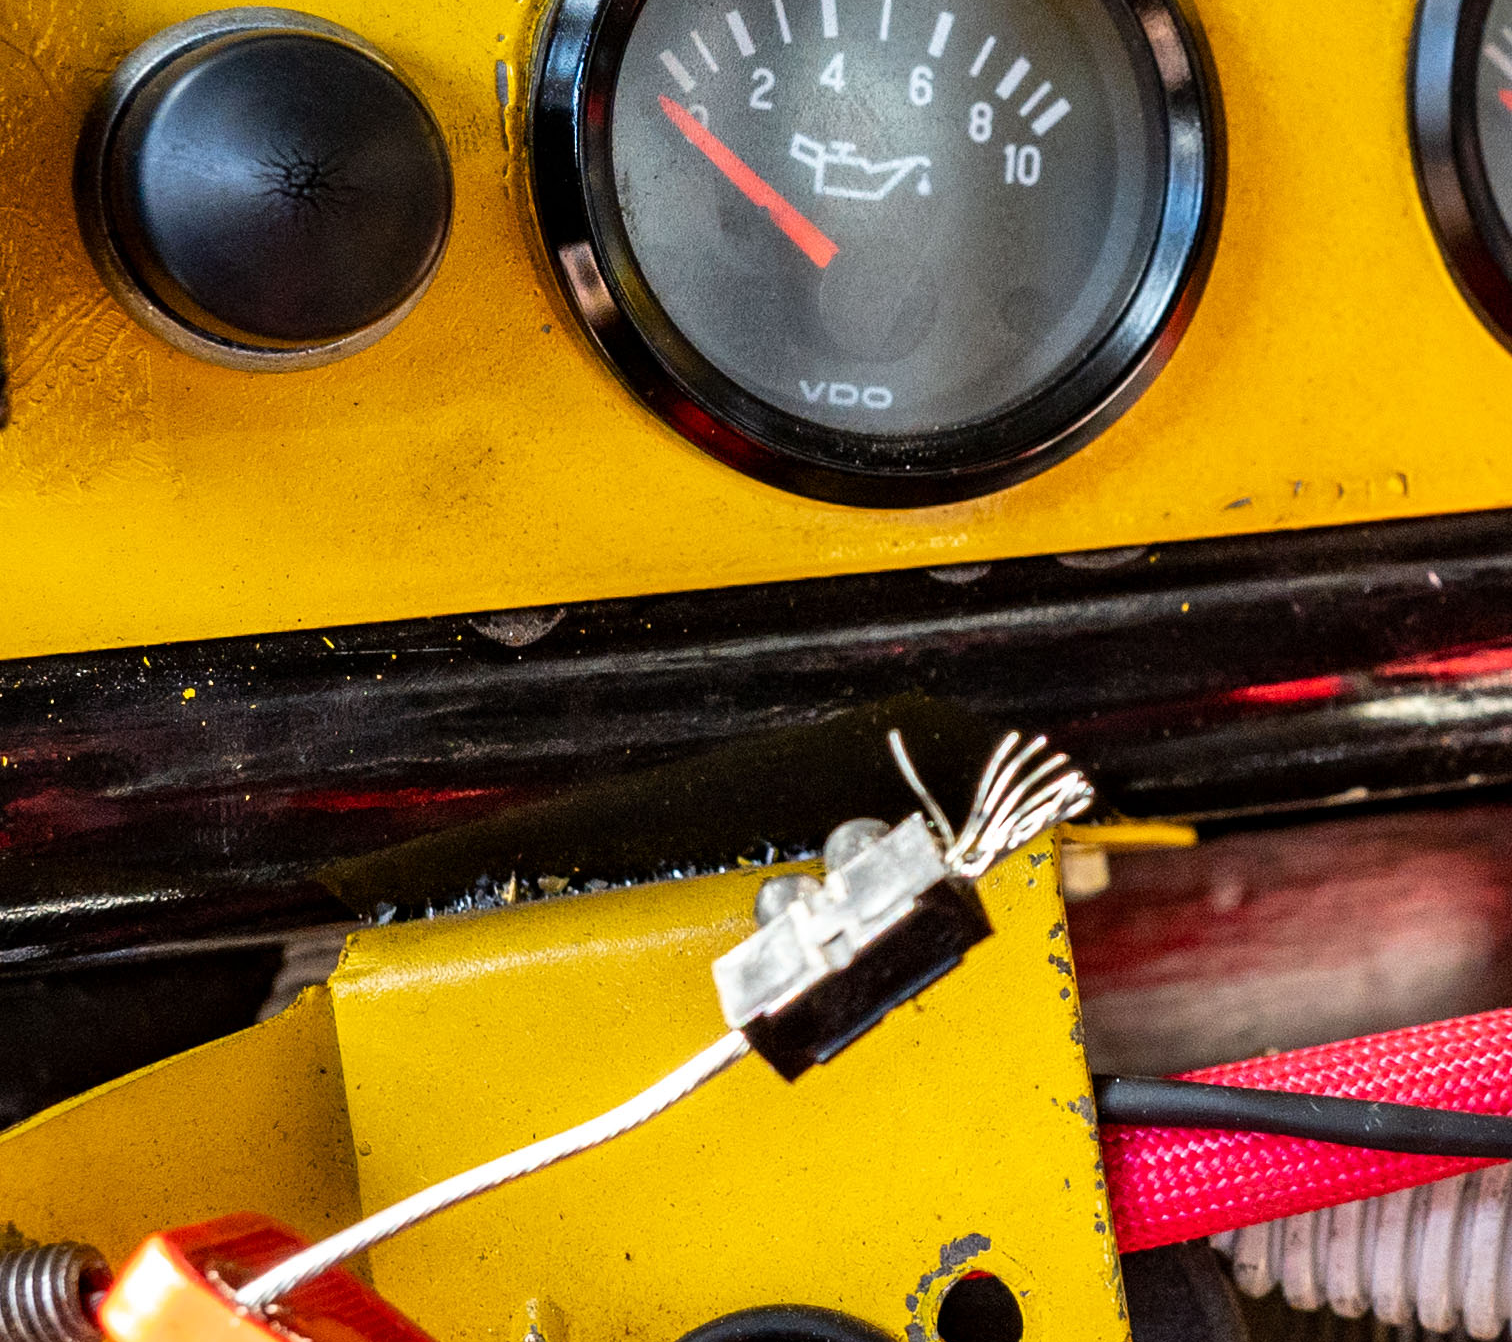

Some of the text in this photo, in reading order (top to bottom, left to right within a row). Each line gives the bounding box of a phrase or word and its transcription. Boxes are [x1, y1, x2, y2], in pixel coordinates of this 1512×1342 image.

[749, 69, 774, 111] 2
[819, 53, 846, 93] 4
[909, 66, 933, 105] 6
[968, 103, 992, 143] 8
[1004, 145, 1041, 187] 10
[798, 380, 893, 409] VDO
